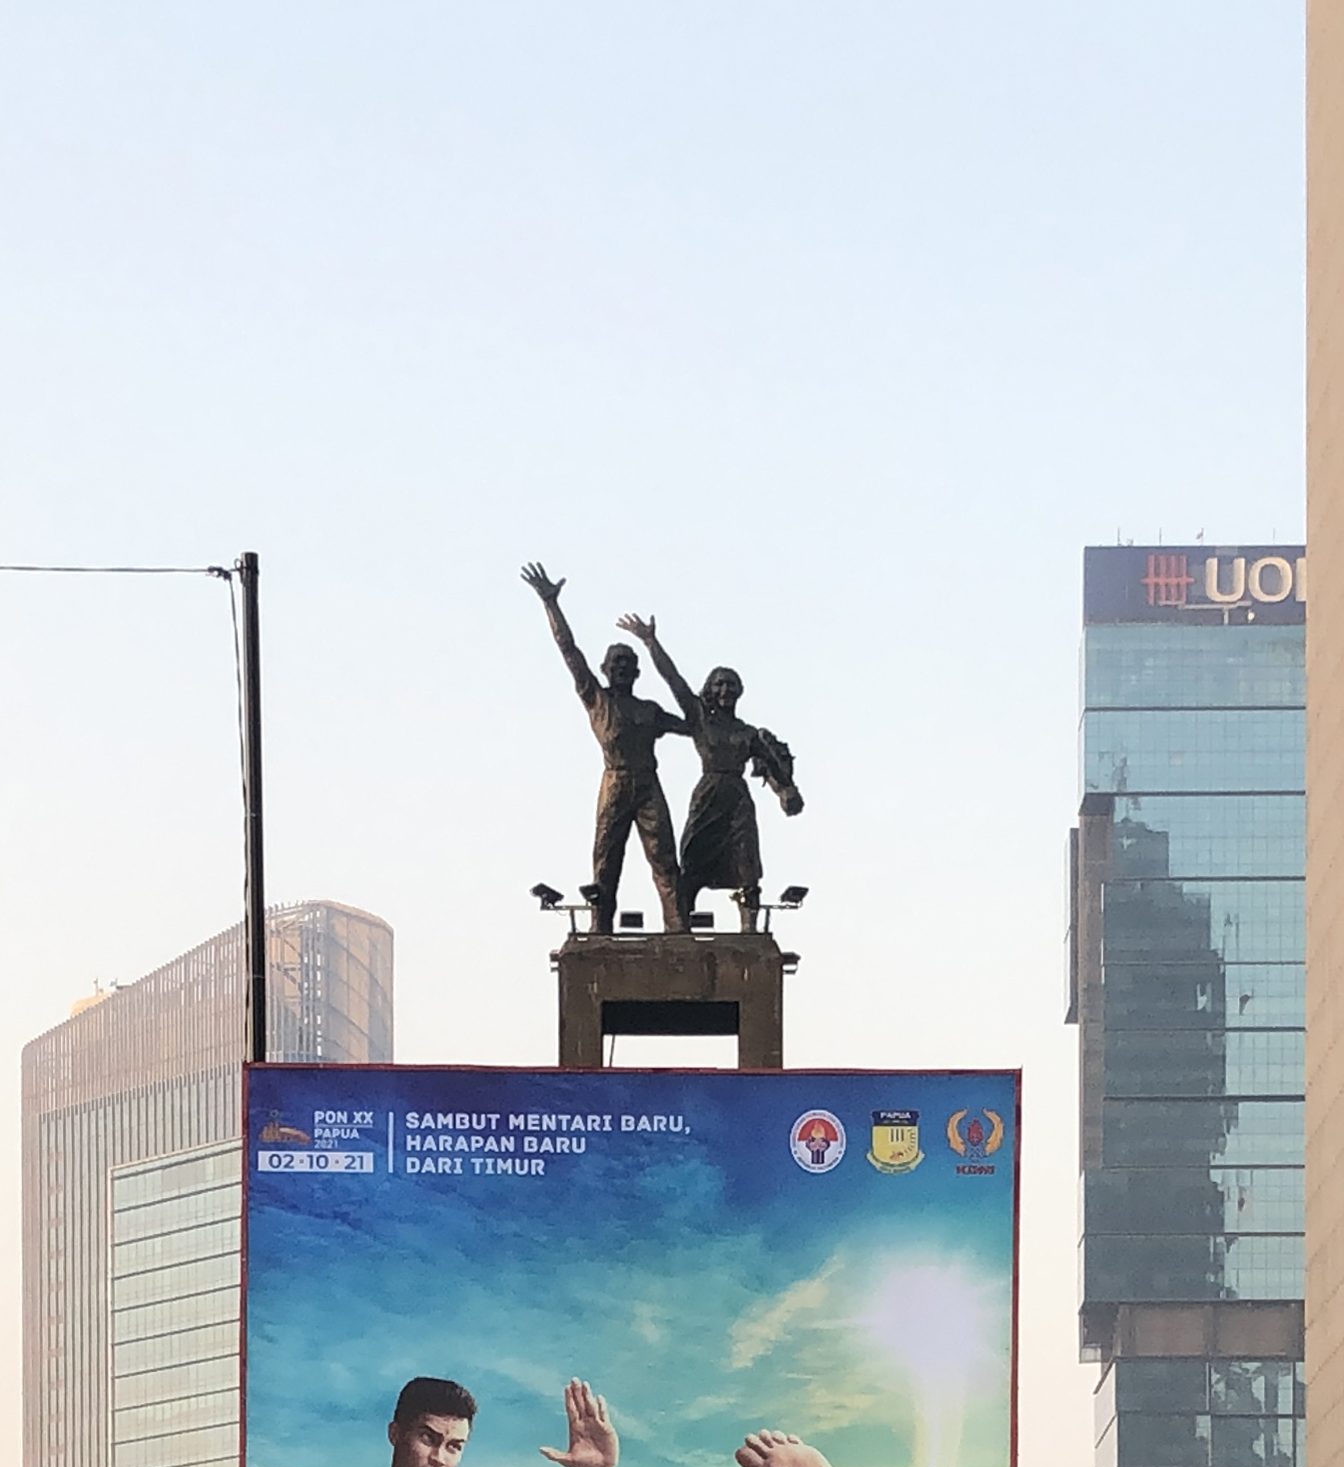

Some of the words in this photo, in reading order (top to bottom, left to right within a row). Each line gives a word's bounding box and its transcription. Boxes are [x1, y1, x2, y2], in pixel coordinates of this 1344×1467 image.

[314, 1110, 348, 1124] PON
[353, 1111, 373, 1124] XX
[406, 1112, 500, 1130] SAMBUT
[509, 1114, 612, 1131] MENTARI
[621, 1115, 691, 1135] BARU,
[314, 1128, 360, 1139] PAPUA
[314, 1139, 338, 1149] 2021
[406, 1135, 515, 1152] HARAPAN
[523, 1136, 586, 1153] BARU
[406, 1156, 463, 1173] DARI
[471, 1158, 545, 1175] TIMUR
